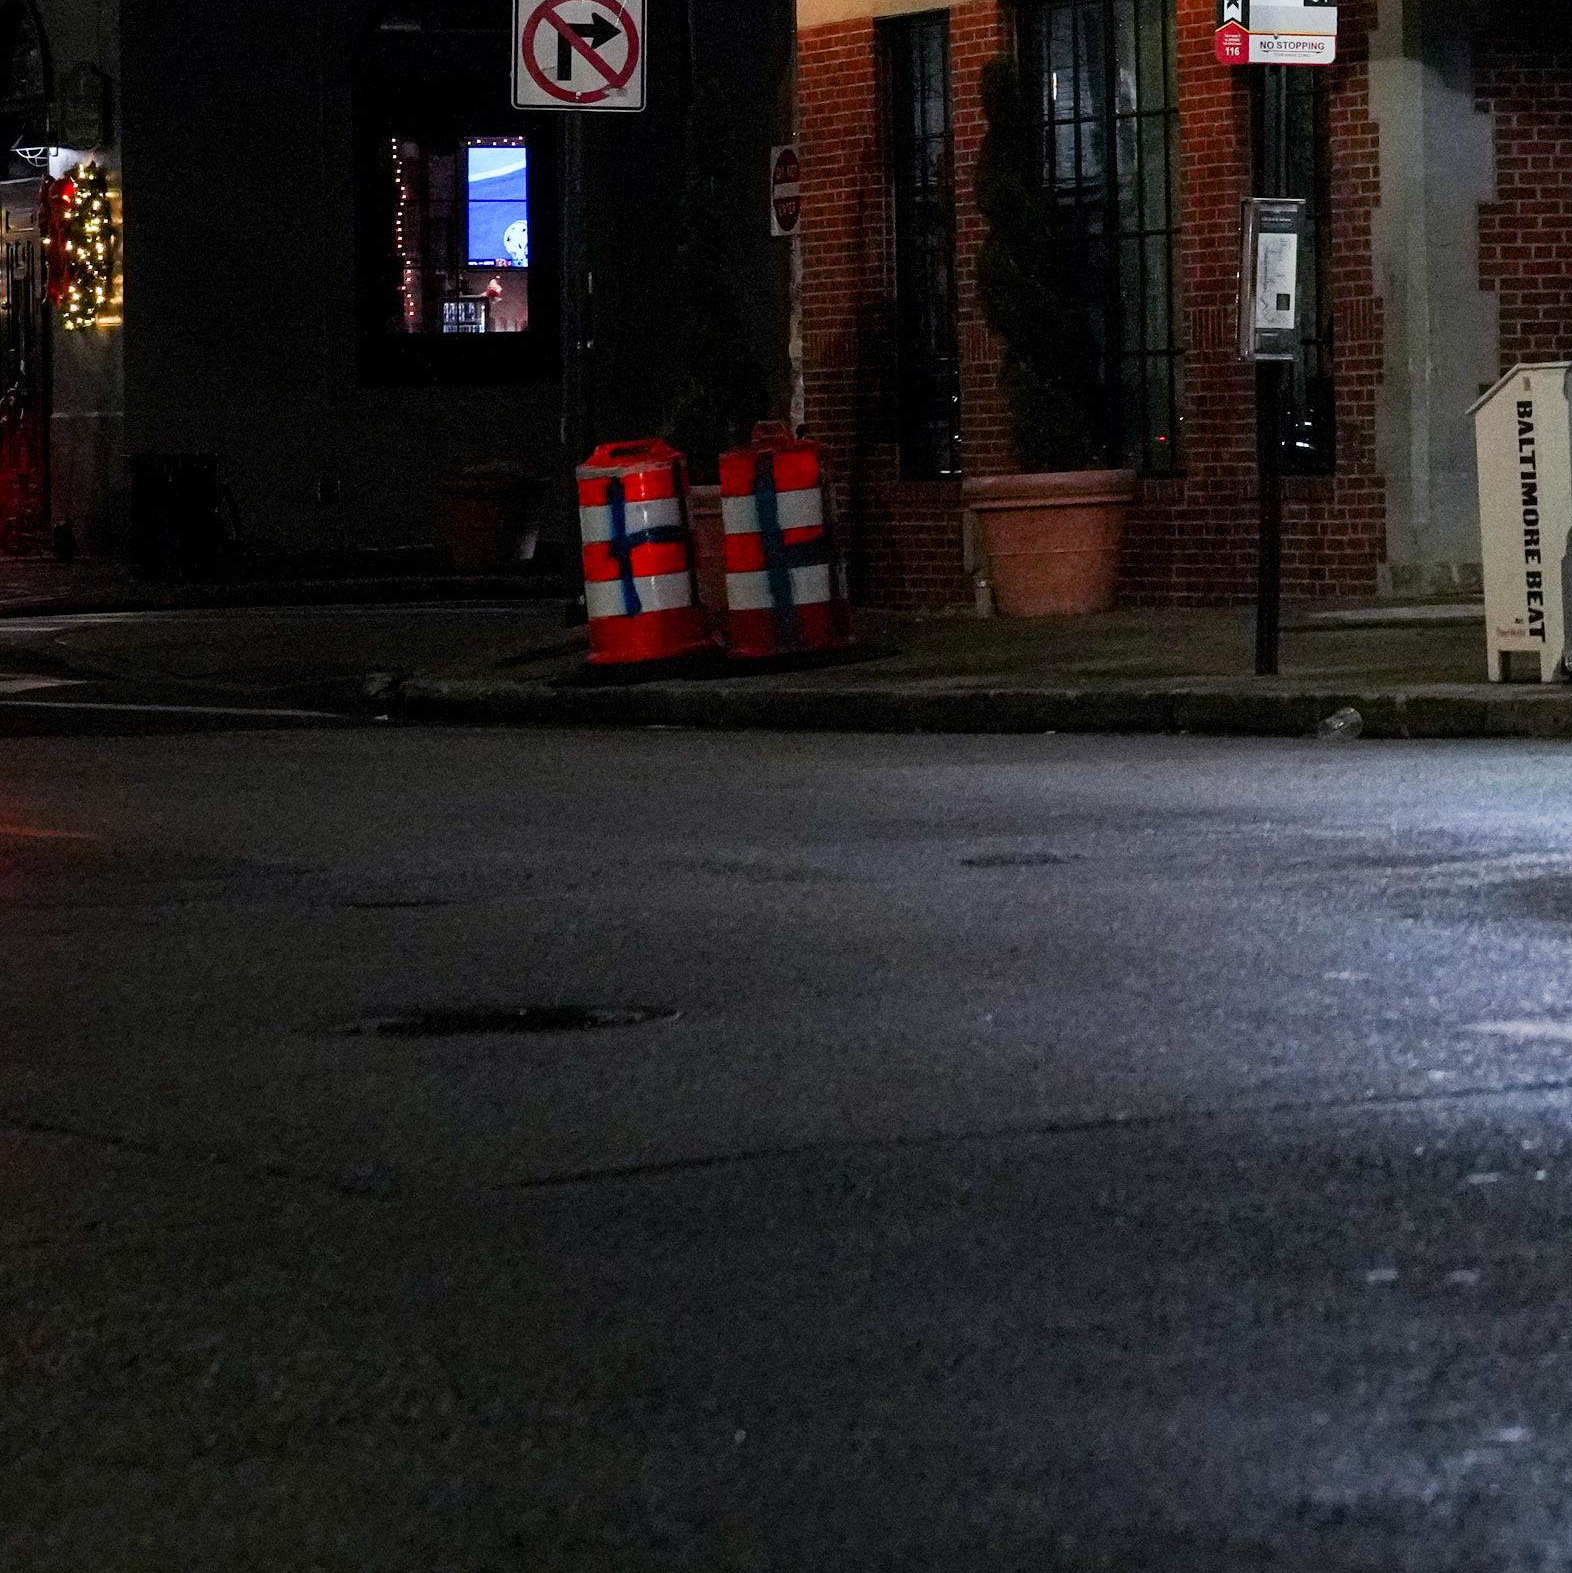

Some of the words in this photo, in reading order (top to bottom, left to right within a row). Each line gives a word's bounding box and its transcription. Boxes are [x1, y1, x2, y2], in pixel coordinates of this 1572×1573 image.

[1225, 47, 1240, 56] 116
[1260, 41, 1274, 49] NO
[1276, 41, 1325, 50] STOPPING
[1517, 401, 1541, 564] BALTIMORE
[1526, 570, 1545, 643] BEAT
